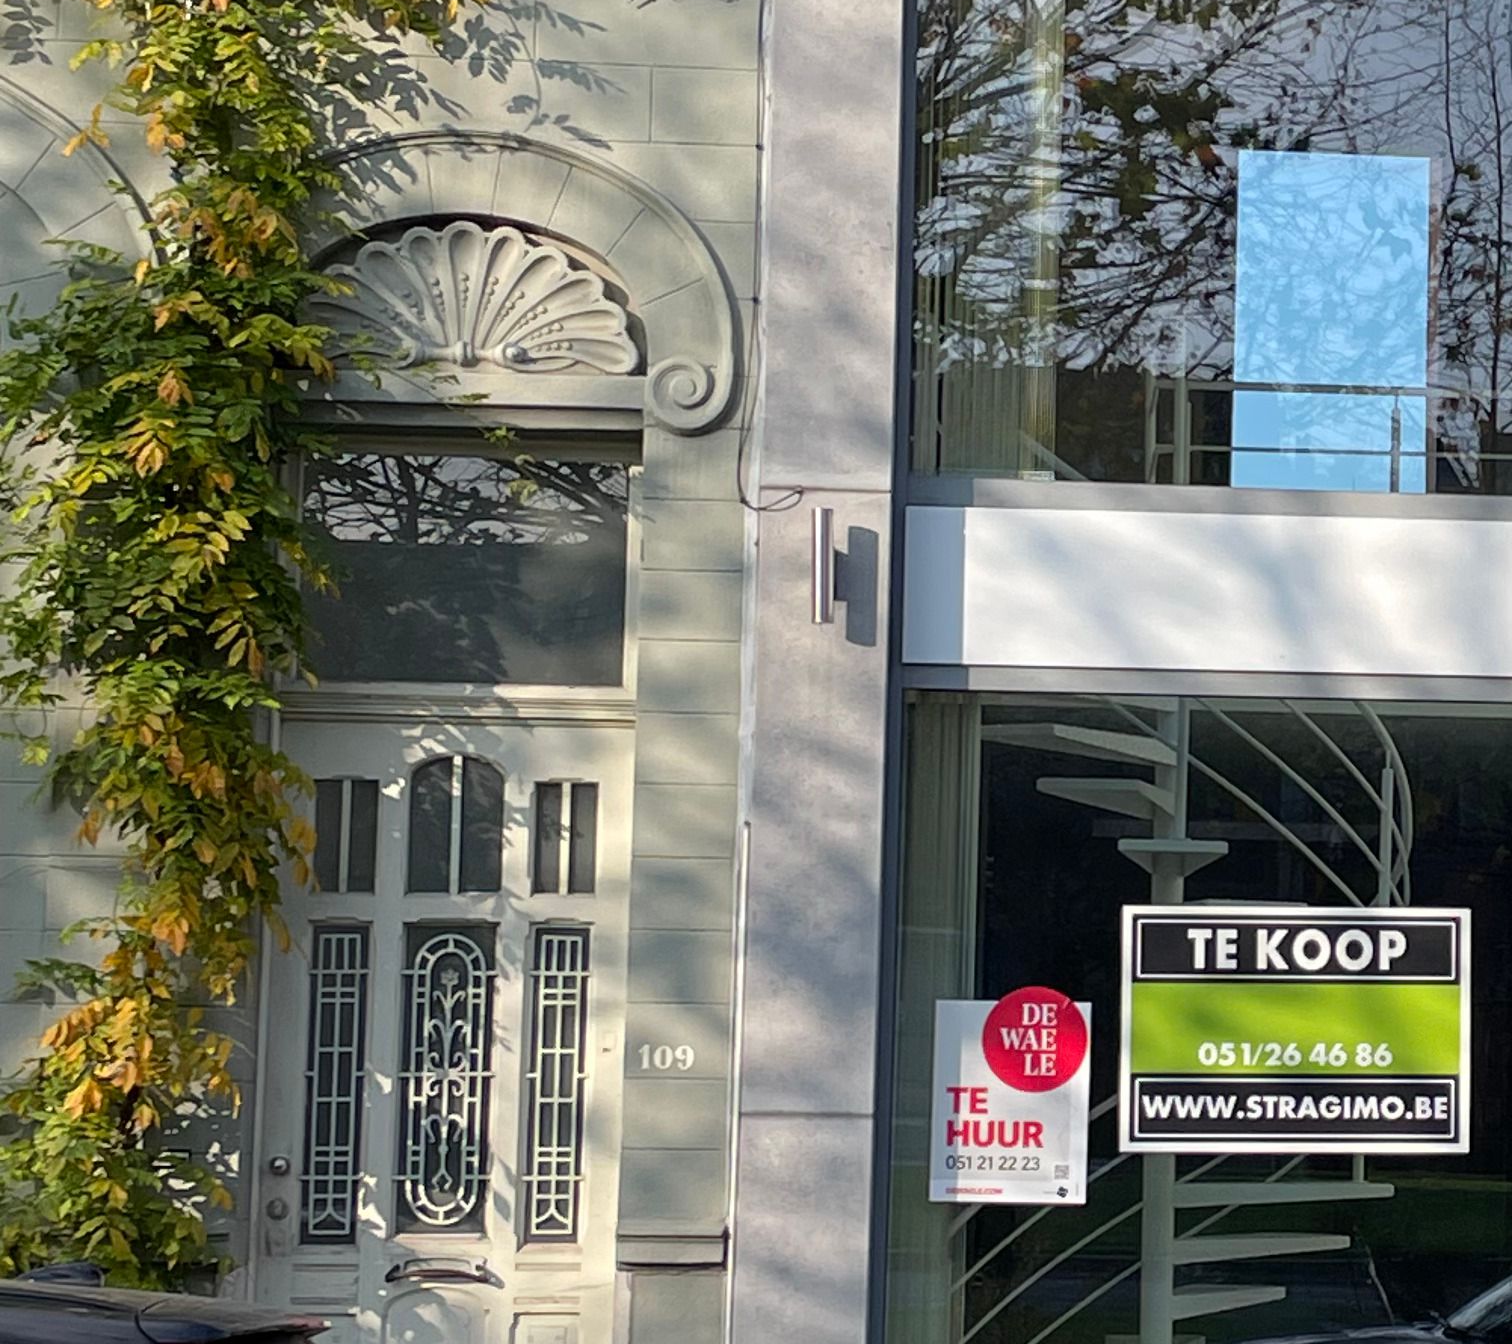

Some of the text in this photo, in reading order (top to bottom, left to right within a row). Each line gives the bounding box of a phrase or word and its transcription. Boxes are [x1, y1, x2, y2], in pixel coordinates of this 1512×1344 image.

[1187, 927, 1407, 972] TE KOOP
[1022, 1003, 1058, 1026] DE
[1000, 1027, 1057, 1051] WAE
[638, 1044, 695, 1071] 109
[1023, 1053, 1057, 1076] LE
[1198, 1042, 1393, 1067] 051/26 46 86
[946, 1086, 989, 1114] TE
[1141, 1094, 1449, 1120] WWW.STRAGIMO.BE
[946, 1120, 1044, 1148] HUUR
[945, 1154, 1041, 1171] 051 21 22 23
